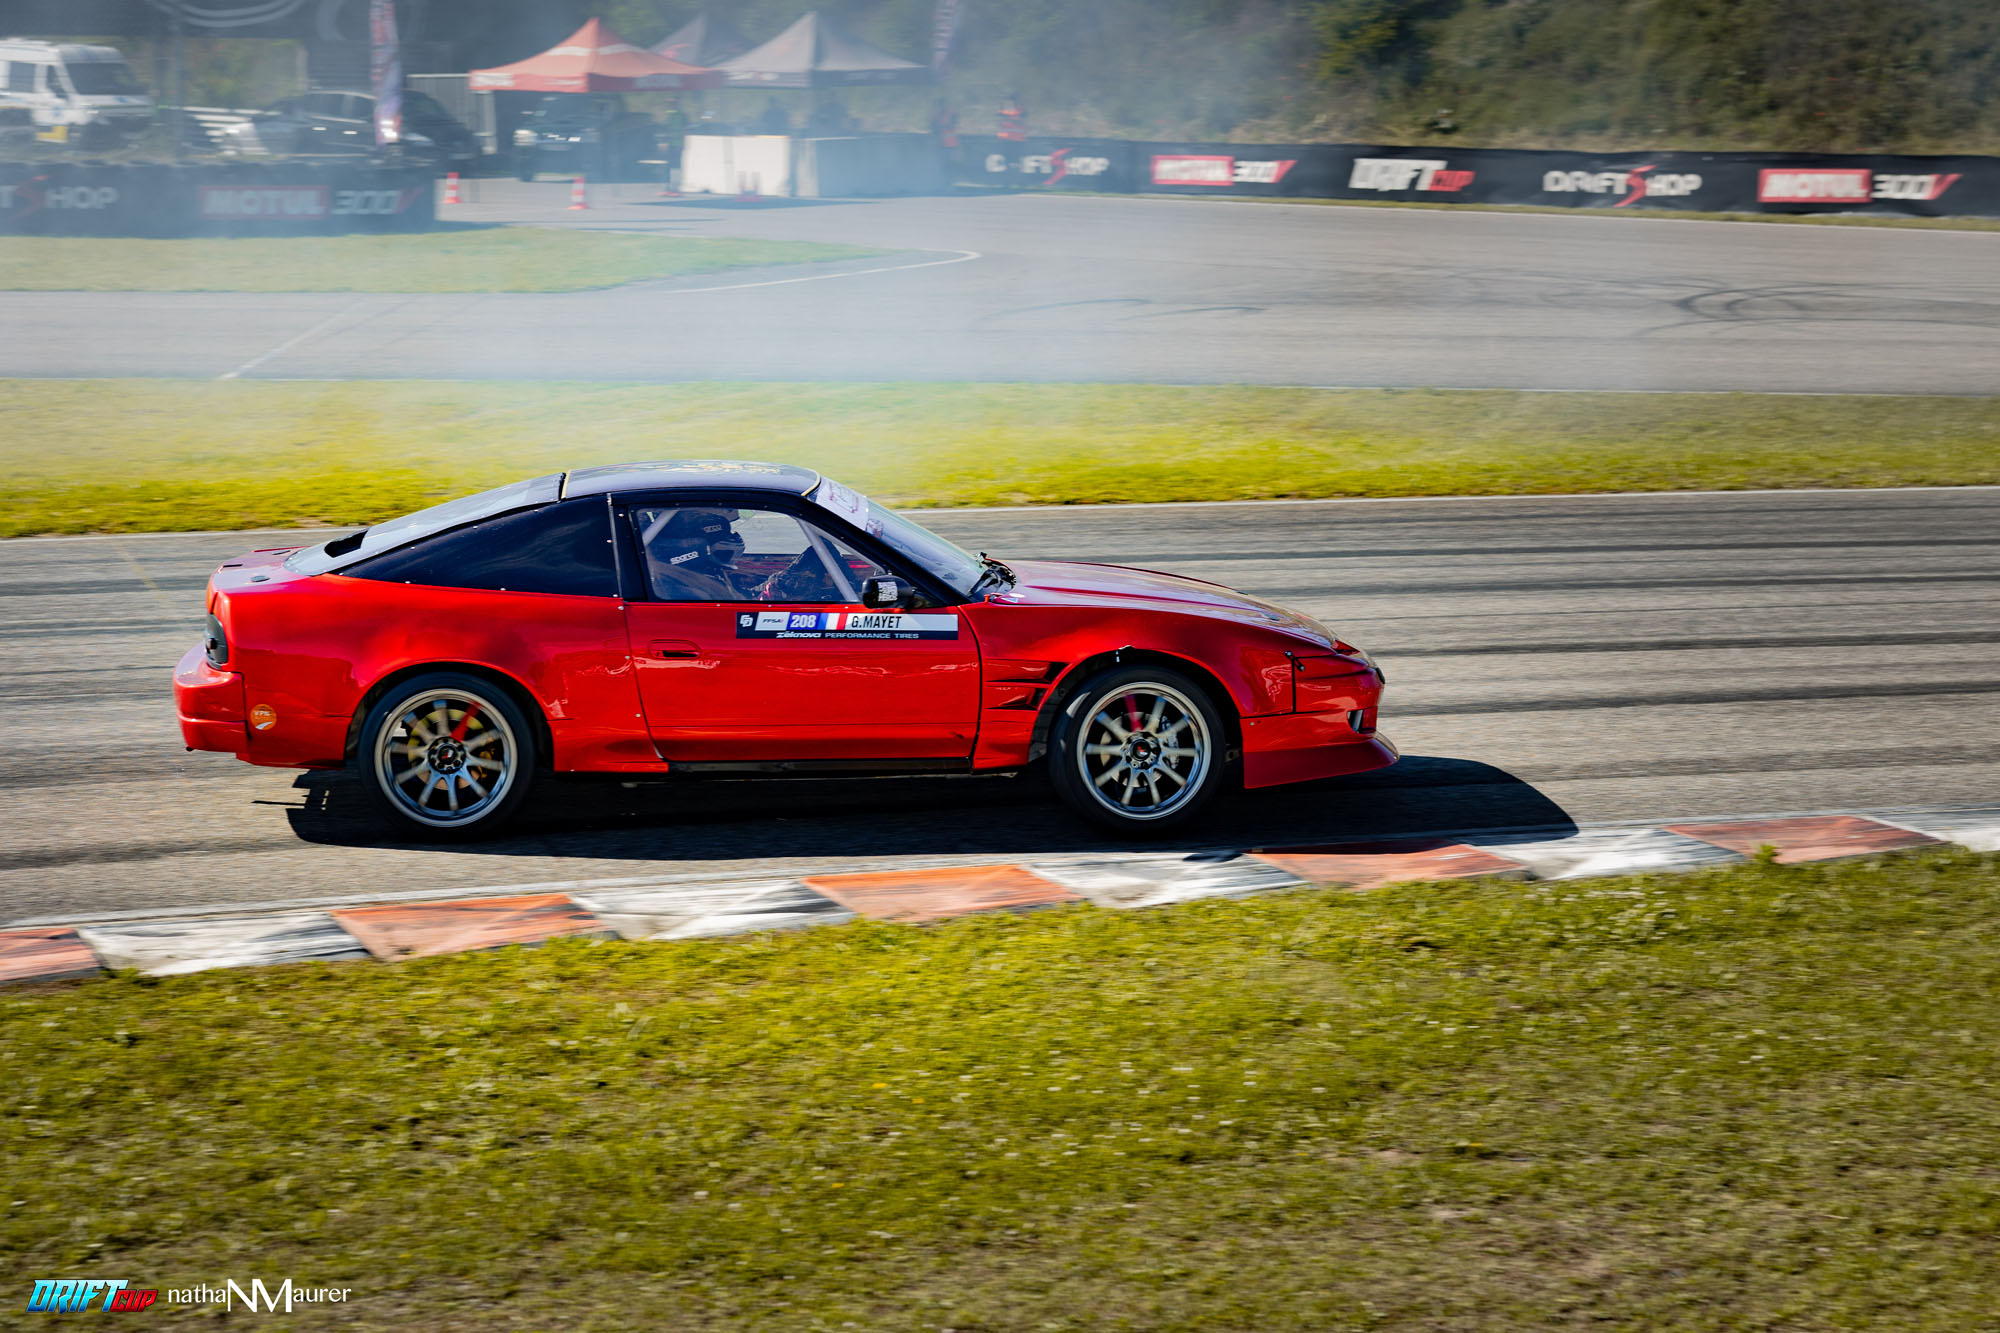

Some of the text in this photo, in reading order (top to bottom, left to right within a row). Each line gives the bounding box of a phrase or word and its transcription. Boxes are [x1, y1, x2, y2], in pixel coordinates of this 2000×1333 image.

[1761, 174, 1869, 198] MOTUL
[790, 614, 817, 628] 208
[851, 615, 902, 629] G.MAYET
